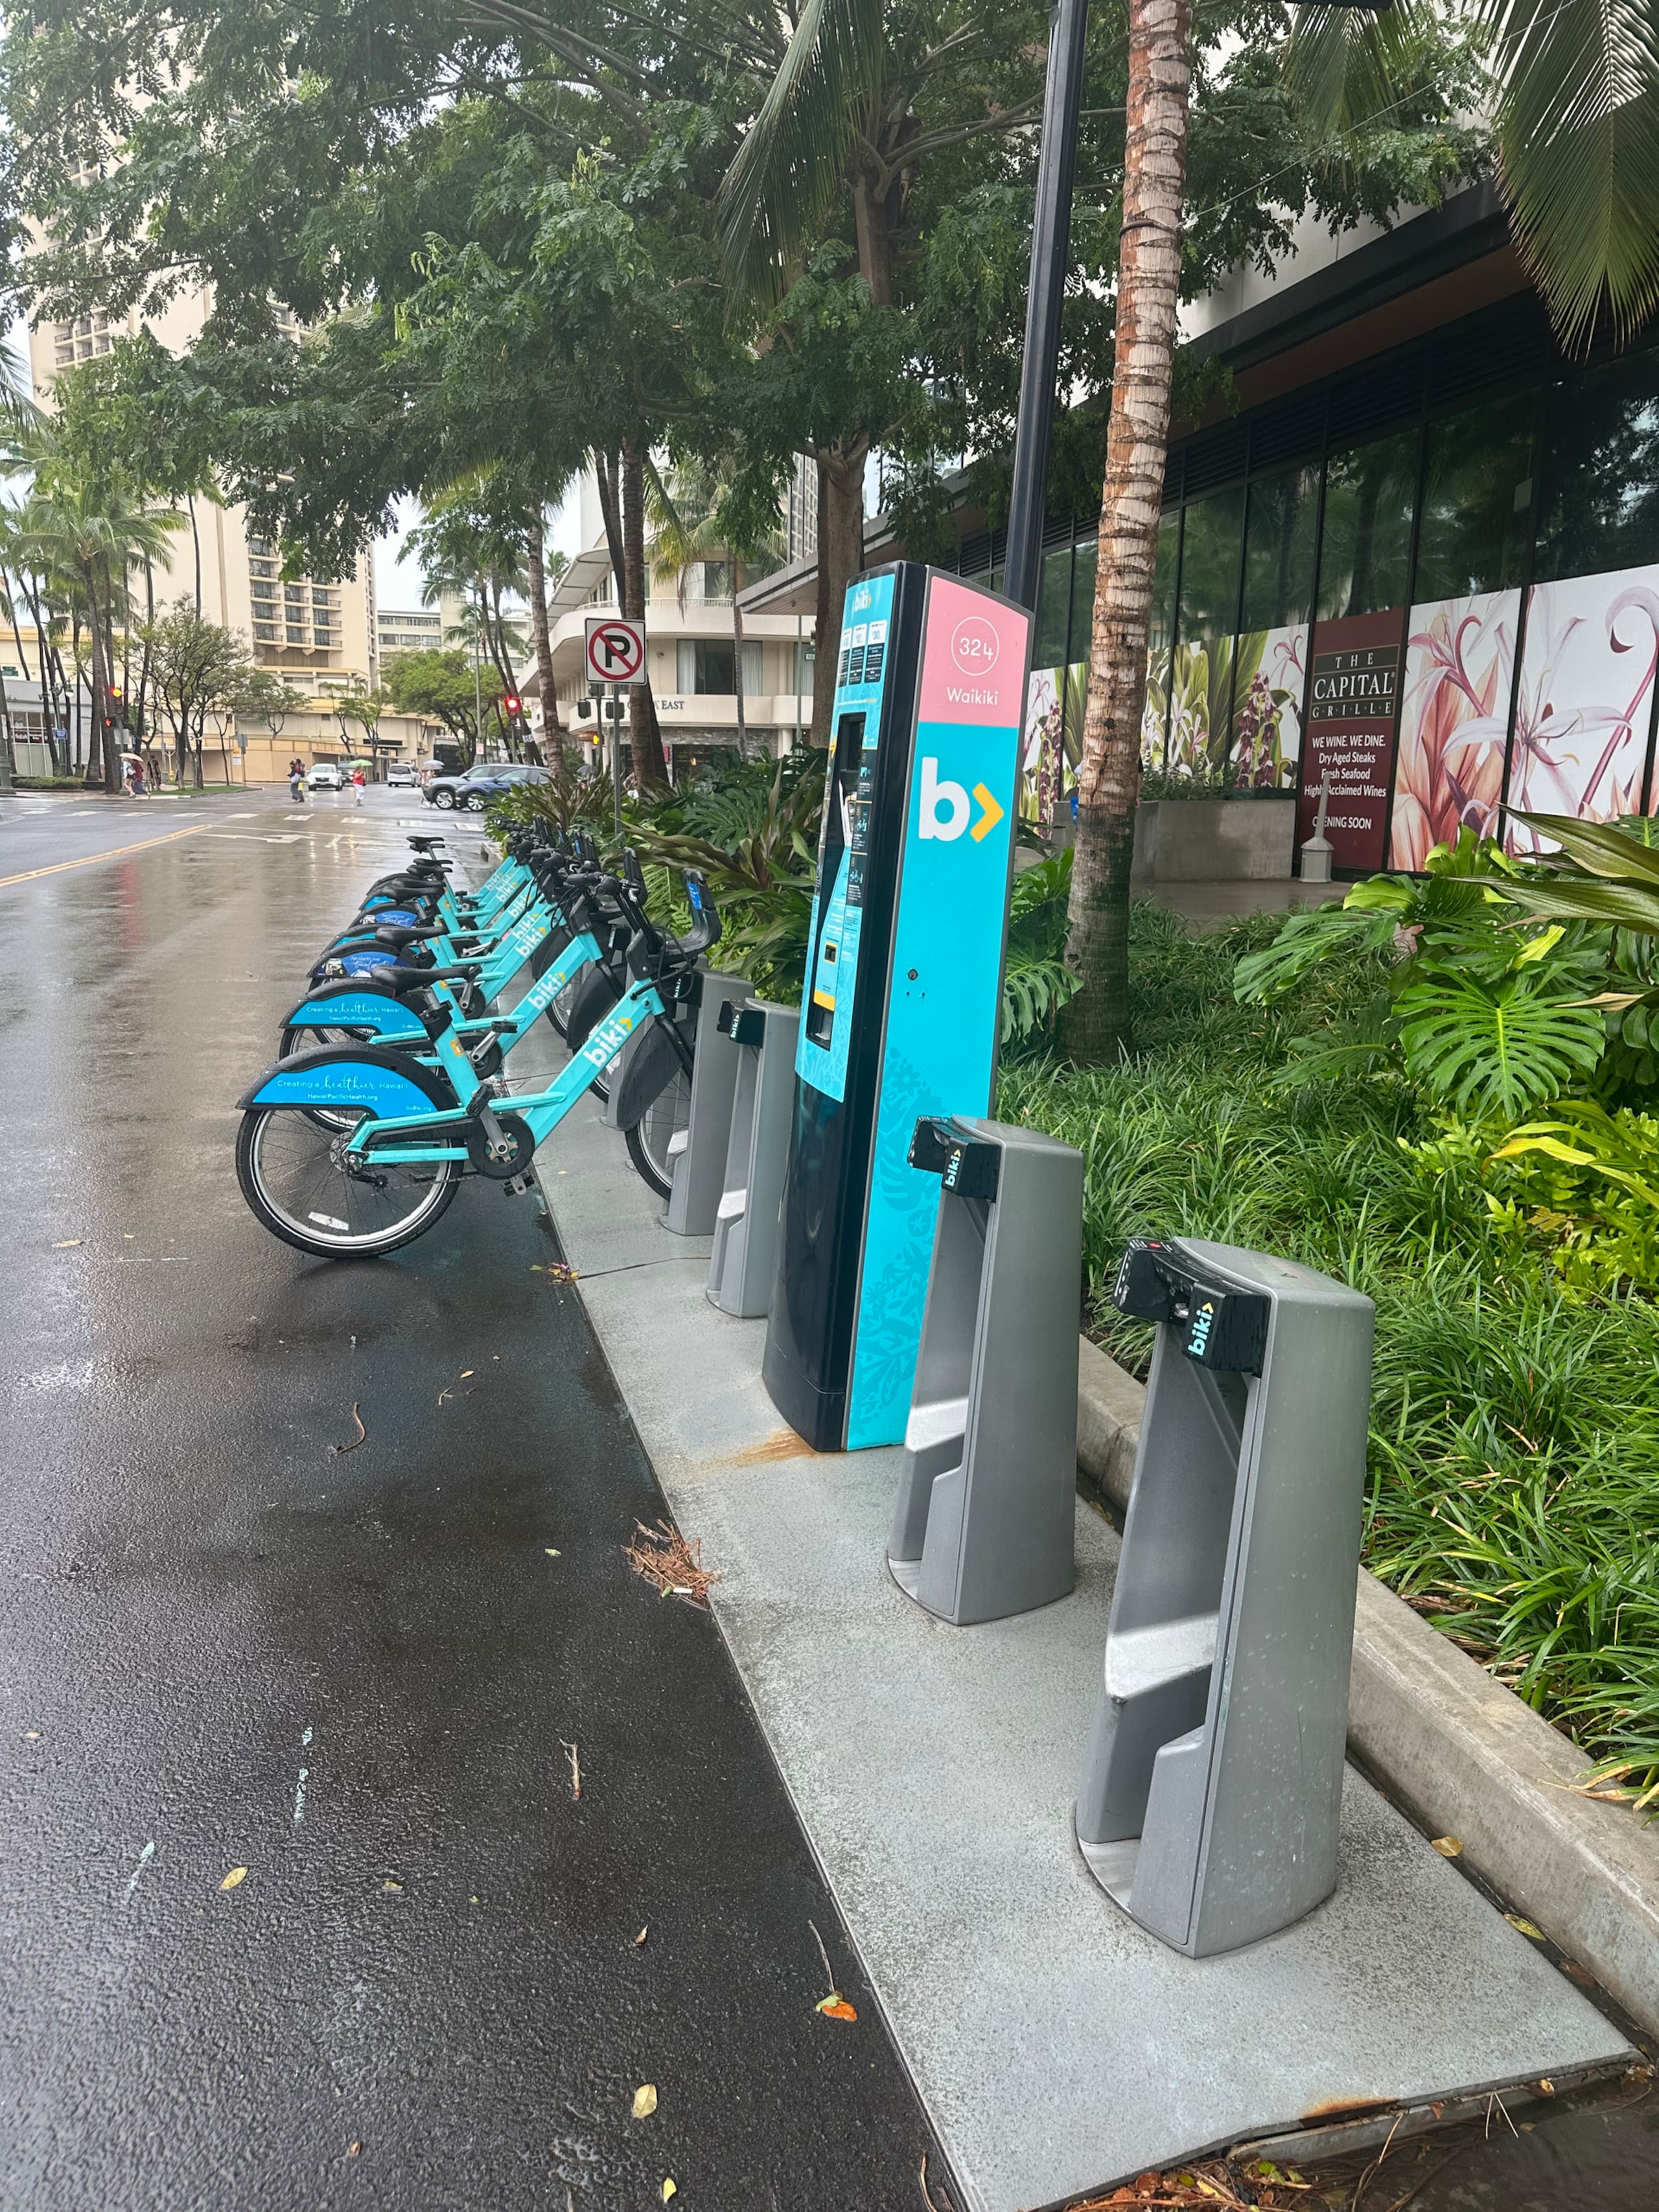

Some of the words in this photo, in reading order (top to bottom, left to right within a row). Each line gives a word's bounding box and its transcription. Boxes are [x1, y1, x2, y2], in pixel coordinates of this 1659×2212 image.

[959, 637, 993, 660] 324
[1336, 653, 1373, 669] THE
[946, 686, 999, 706] Waikiki
[1314, 672, 1393, 699] CAPITAL
[662, 700, 684, 710] EAST
[1312, 736, 1325, 748] WE
[1350, 735, 1363, 746] WE
[1364, 735, 1386, 747] DINE.
[1319, 752, 1332, 765] Dry
[1332, 752, 1351, 765] Aged
[1352, 752, 1376, 763] Steaks
[1341, 768, 1371, 780] Seafood
[1328, 784, 1362, 796] Acclaimed
[1363, 785, 1387, 797] Wines
[1348, 817, 1372, 830] SOON
[496, 883, 515, 903] biki
[507, 896, 528, 918] biki
[512, 914, 536, 940] biki
[515, 928, 544, 958] biki
[528, 973, 563, 1010] biki
[730, 1017, 740, 1039] biki
[583, 1019, 629, 1068] biki
[277, 1079, 313, 1089] Creating
[321, 1073, 375, 1091] healthier
[944, 1154, 960, 1187] biki
[1187, 1309, 1212, 1356] biki
